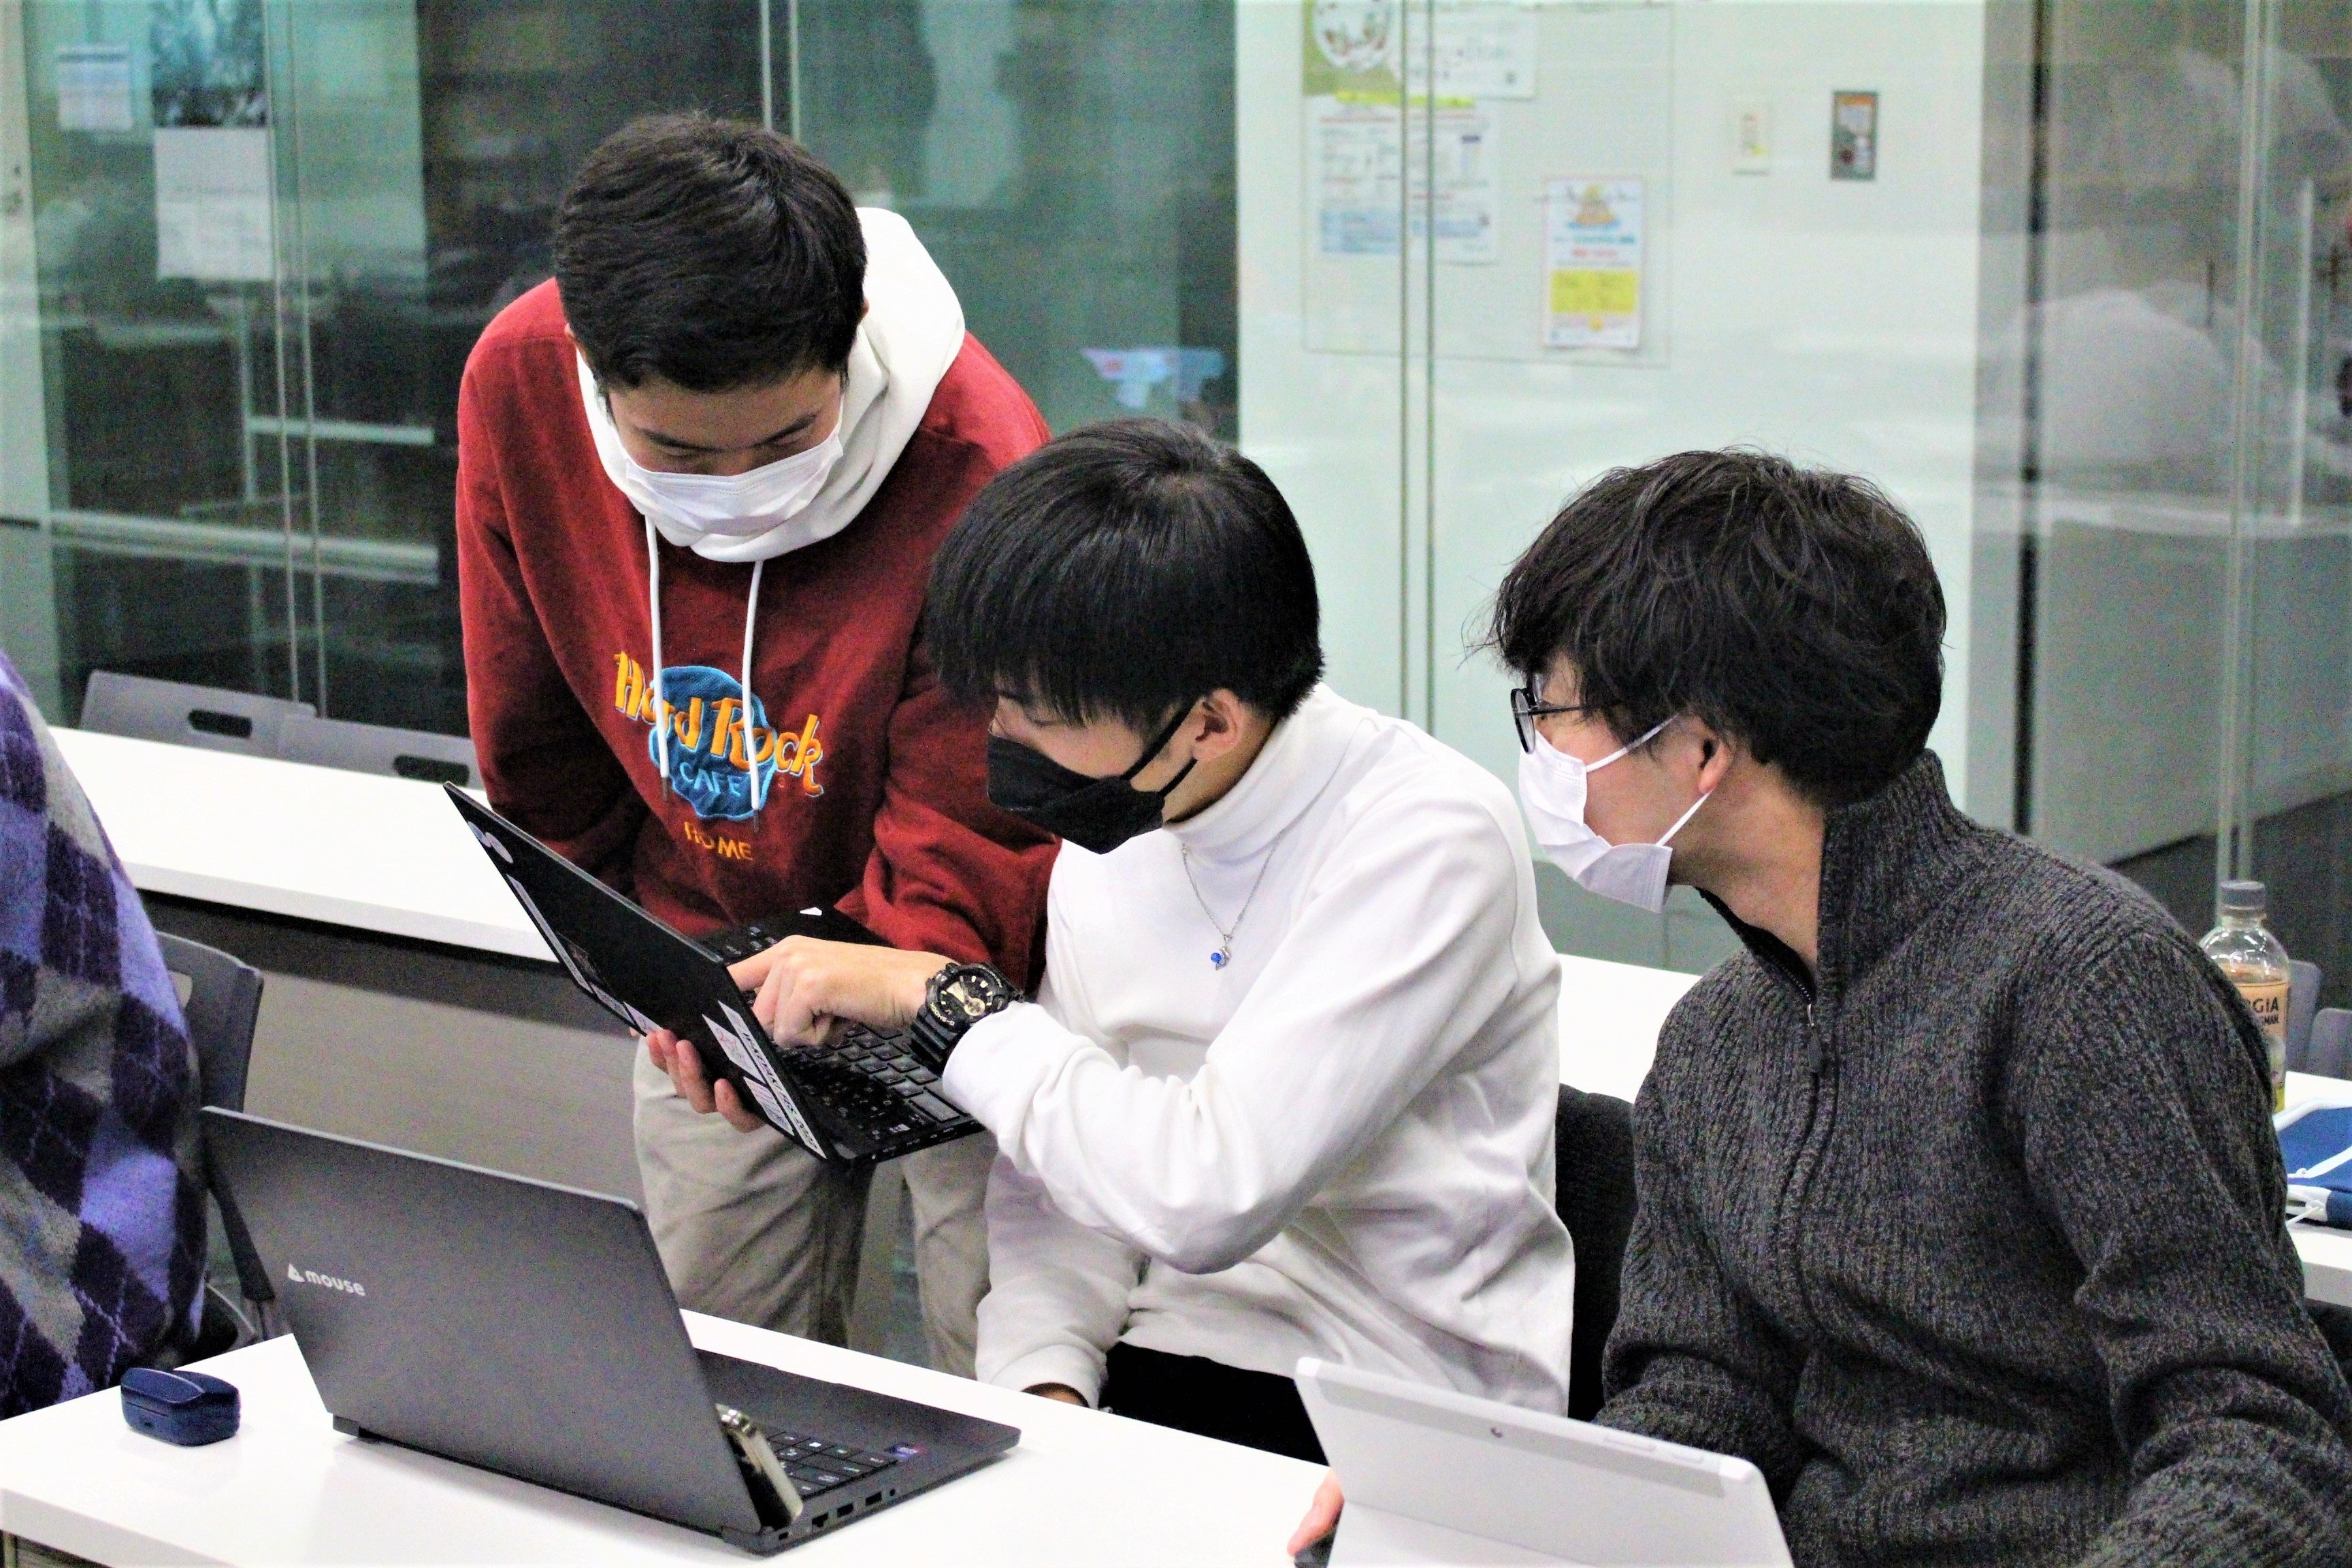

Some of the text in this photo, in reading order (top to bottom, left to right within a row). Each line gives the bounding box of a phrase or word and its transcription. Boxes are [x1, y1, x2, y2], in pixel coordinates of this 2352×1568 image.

[710, 697, 824, 798] Rock
[679, 762, 743, 797] CAFE
[684, 821, 753, 860] ROME
[305, 1270, 366, 1296] mouse
